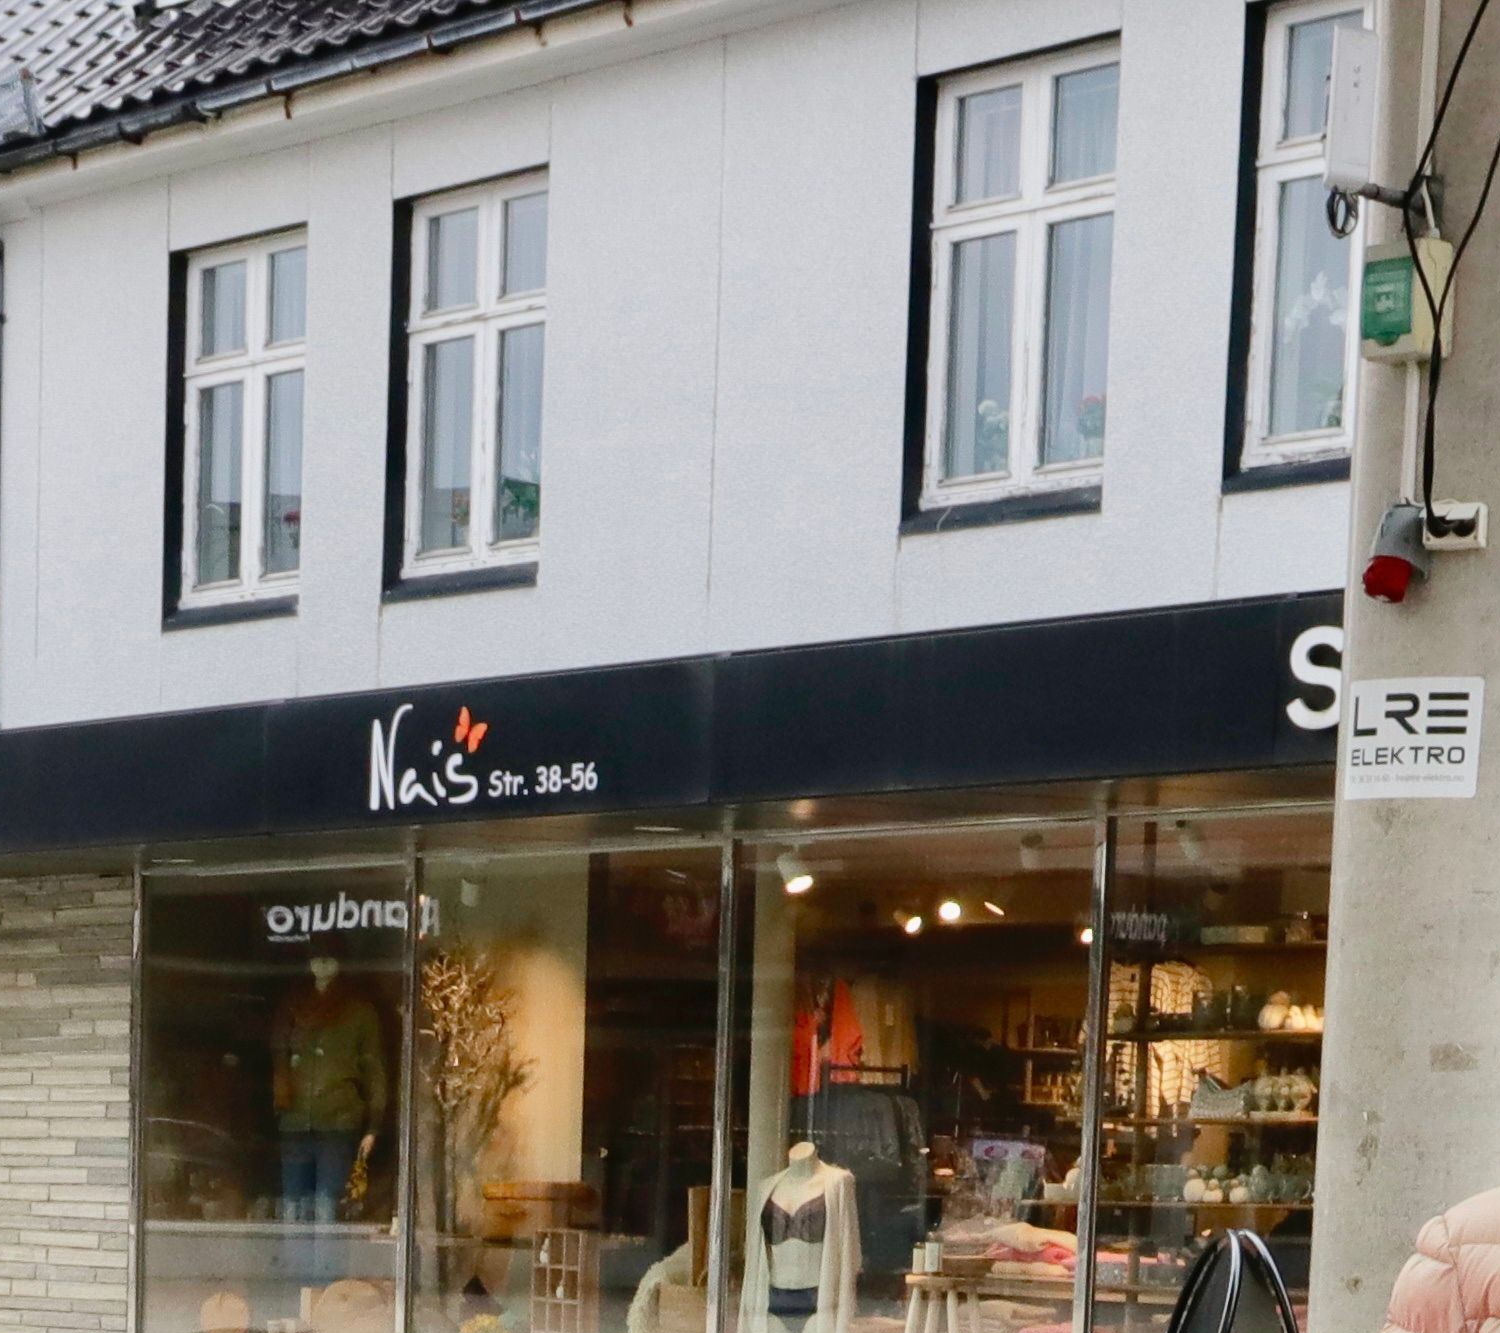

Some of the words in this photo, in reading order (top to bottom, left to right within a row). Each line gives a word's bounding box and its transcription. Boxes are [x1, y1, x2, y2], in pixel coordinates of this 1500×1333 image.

[369, 703, 479, 811] Nais
[488, 769, 529, 798] Str.
[535, 761, 599, 794] 38-56
[1351, 746, 1466, 767] ELEKTRO
